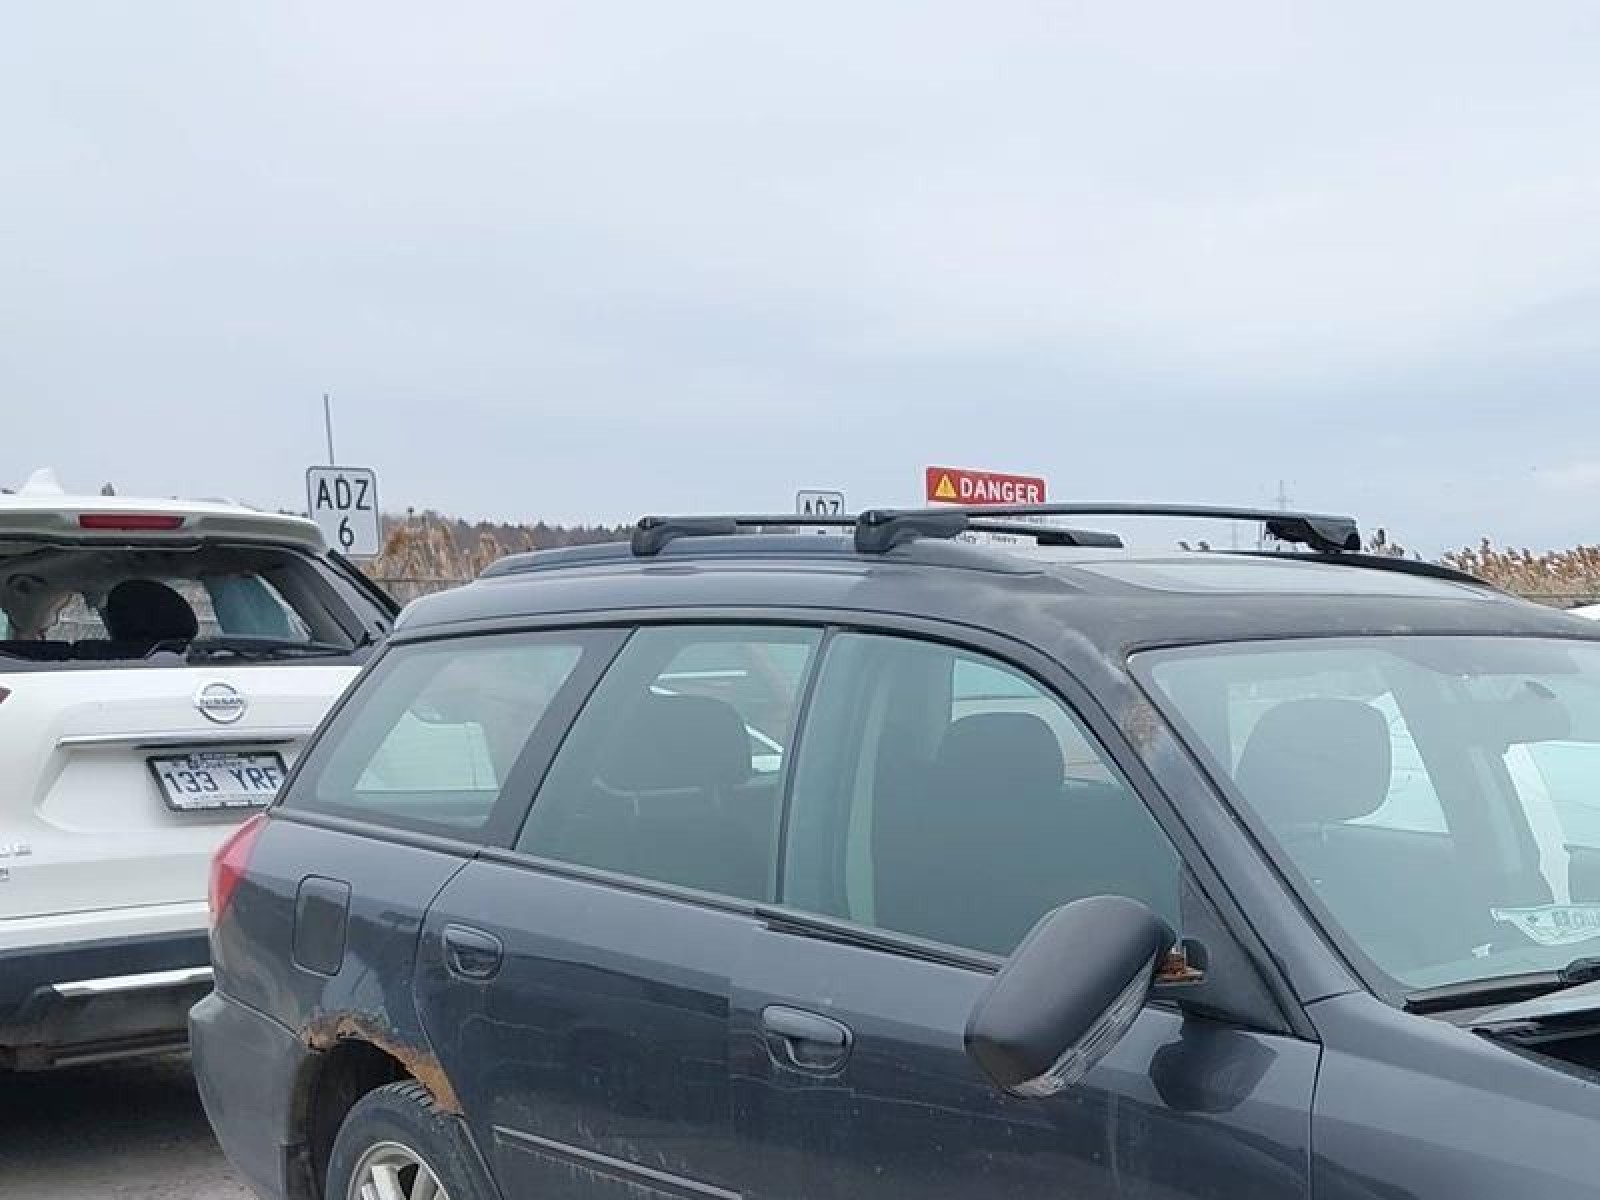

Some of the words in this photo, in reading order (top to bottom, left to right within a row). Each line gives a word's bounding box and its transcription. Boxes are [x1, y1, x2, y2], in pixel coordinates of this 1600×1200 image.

[317, 477, 372, 510] ADZ
[959, 477, 1040, 504] DANGER
[339, 515, 355, 547] 6
[163, 770, 220, 794] 133
